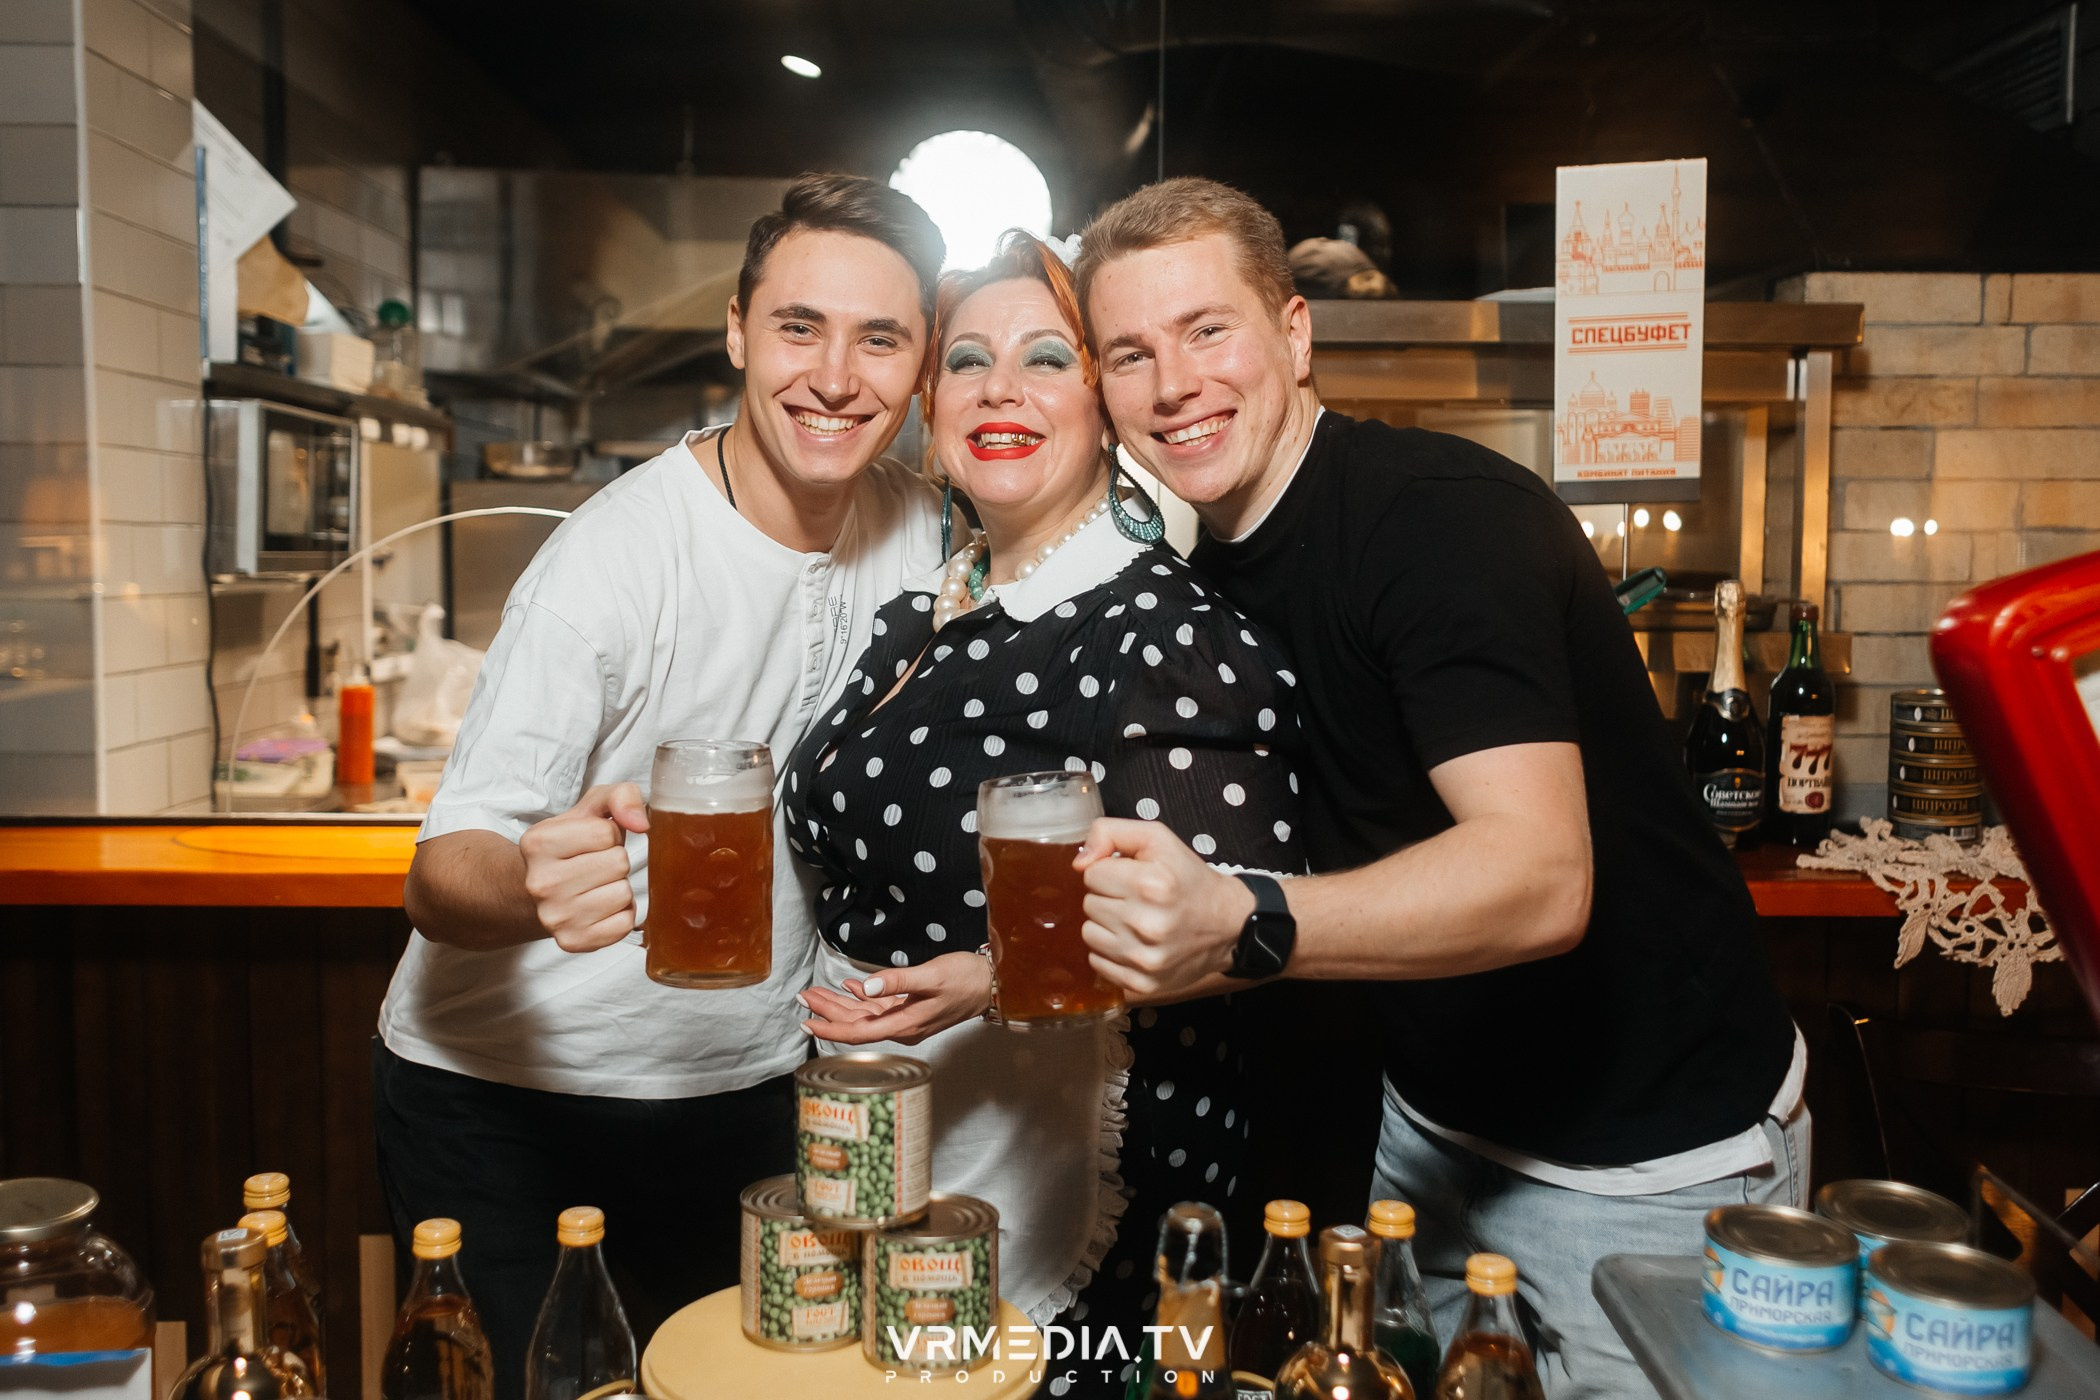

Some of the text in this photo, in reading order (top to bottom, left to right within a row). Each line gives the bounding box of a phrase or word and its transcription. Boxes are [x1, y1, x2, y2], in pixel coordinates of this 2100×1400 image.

[1572, 322, 1692, 344] СПЕЦБУФЕТ
[1789, 743, 1834, 774] 777
[1912, 799, 1968, 811] ШПРОТЫ
[791, 1231, 849, 1248] ОВОЩ
[900, 1258, 960, 1274] ОВОЩ
[1732, 1267, 1834, 1307] САЙРА
[1729, 1296, 1832, 1324] ПРИМОРСКАЯ
[1905, 1311, 2015, 1351] САЙРА
[1903, 1341, 2014, 1369] ПРИМОРСКАЯ
